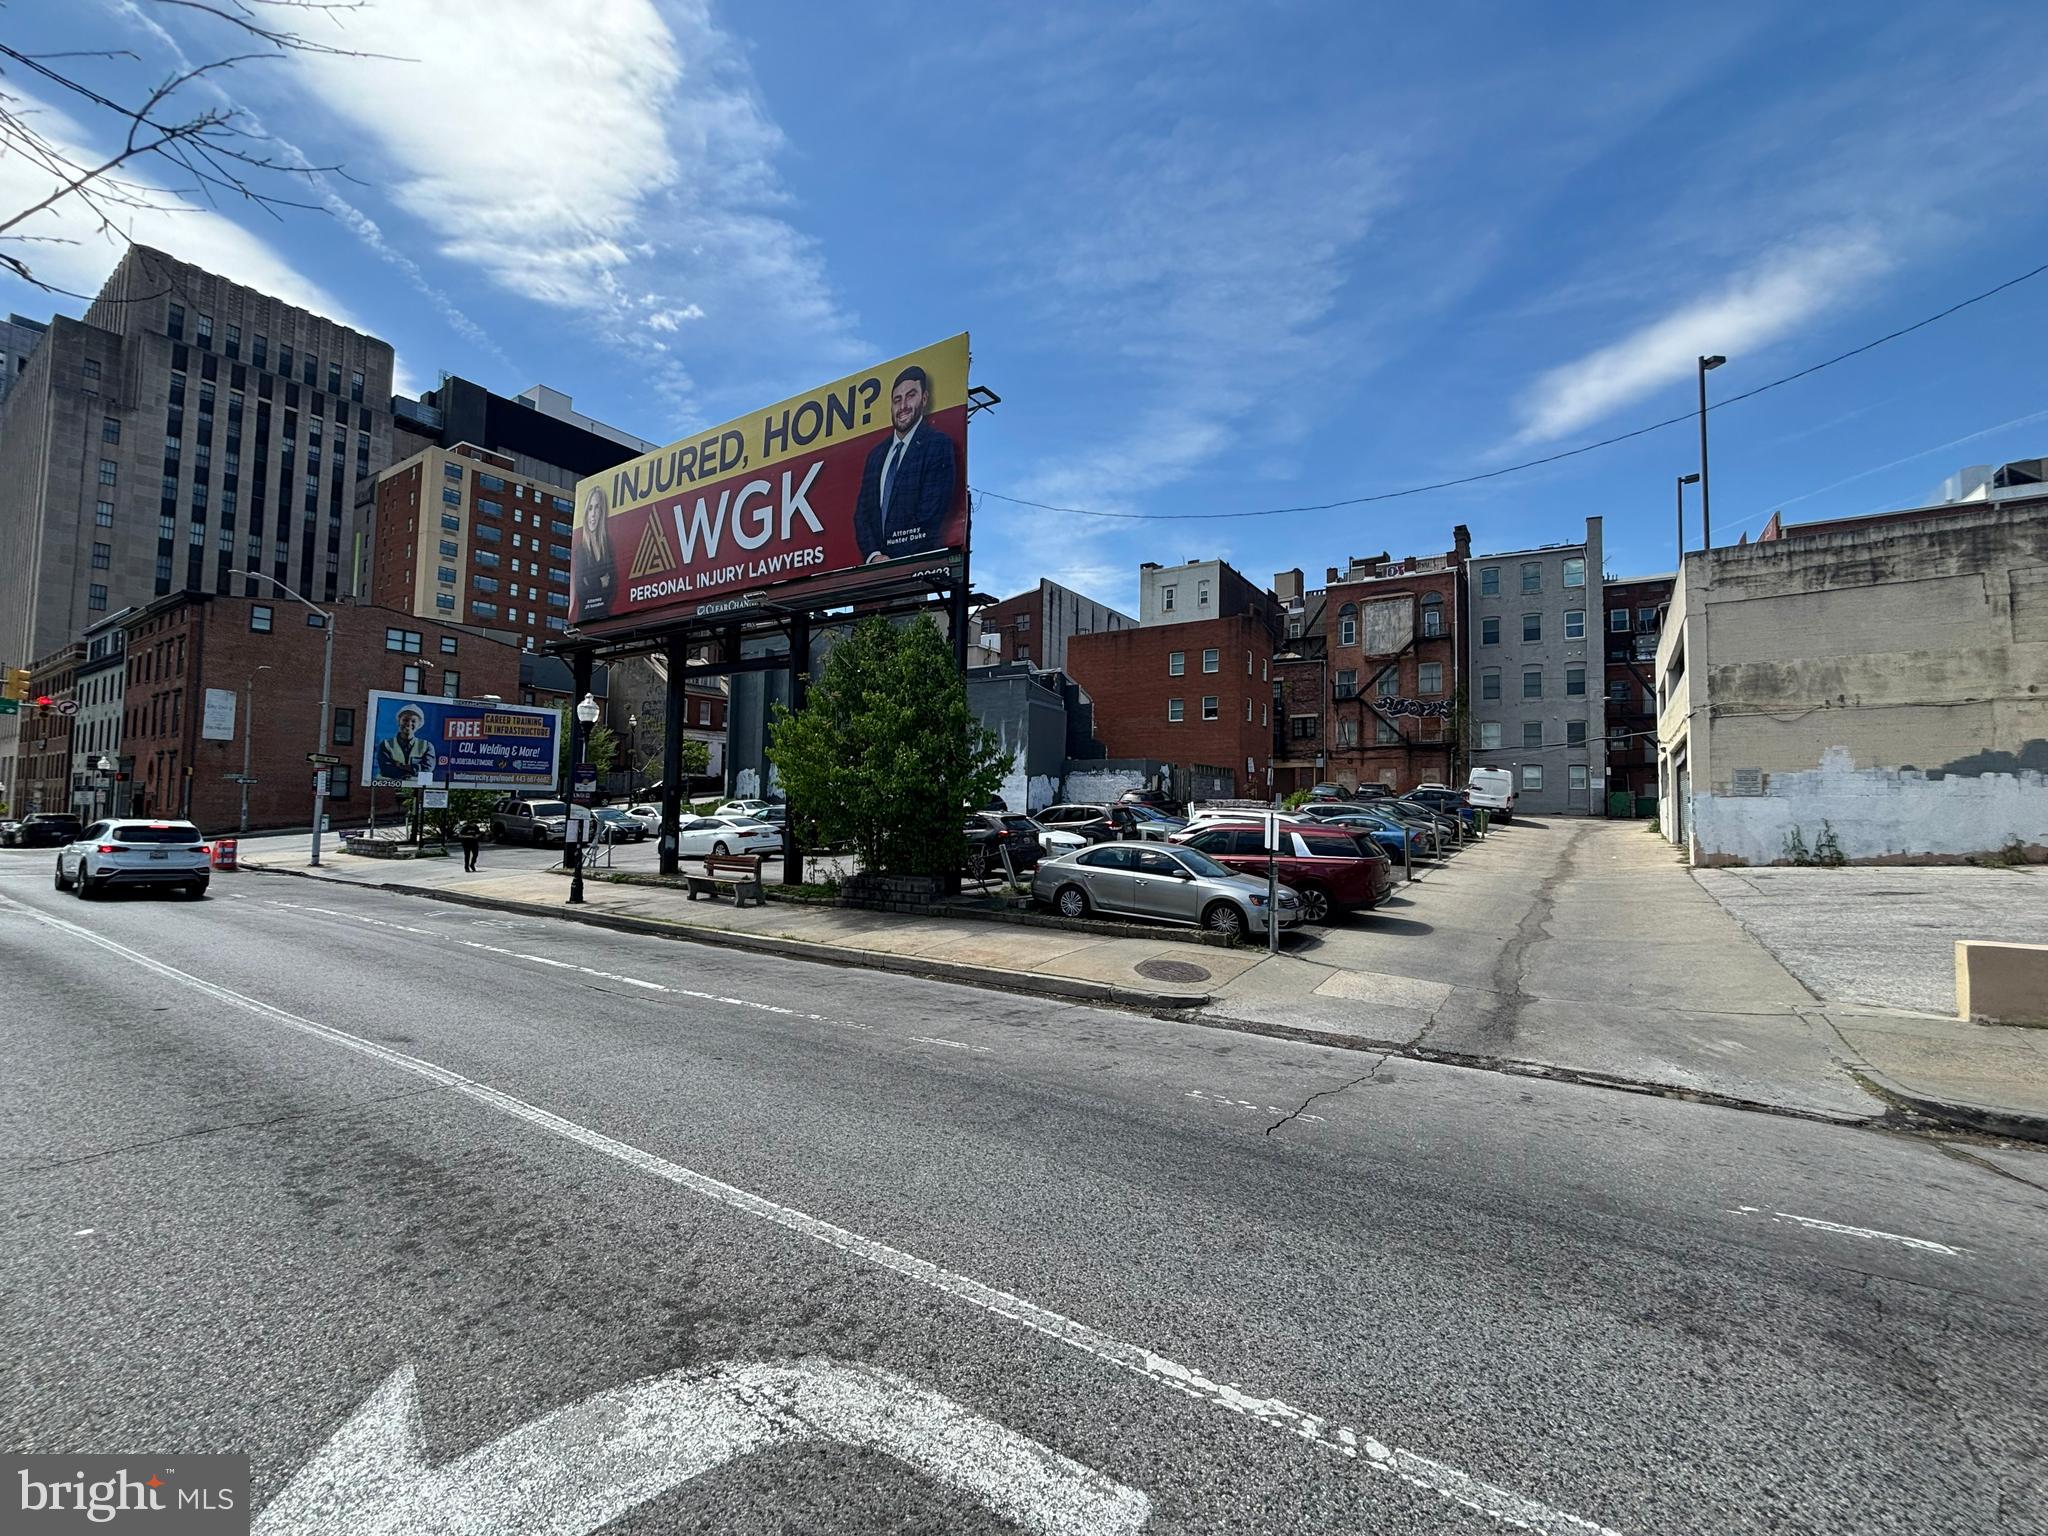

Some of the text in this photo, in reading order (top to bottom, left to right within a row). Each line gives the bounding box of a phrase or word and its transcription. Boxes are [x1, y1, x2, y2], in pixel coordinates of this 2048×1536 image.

[612, 378, 881, 508] INJURED, HON?
[673, 461, 824, 564] WGK
[887, 532, 926, 546] Hunter Duke
[892, 527, 920, 538] Attorney
[630, 546, 824, 602] PERSONAL INJURY LAWYERS
[485, 715, 542, 726] CAREER TRAINING
[448, 721, 480, 737] FREE
[485, 725, 548, 737] IN INFRASTRUCTURE
[459, 742, 541, 758] CDL, Welding & More!
